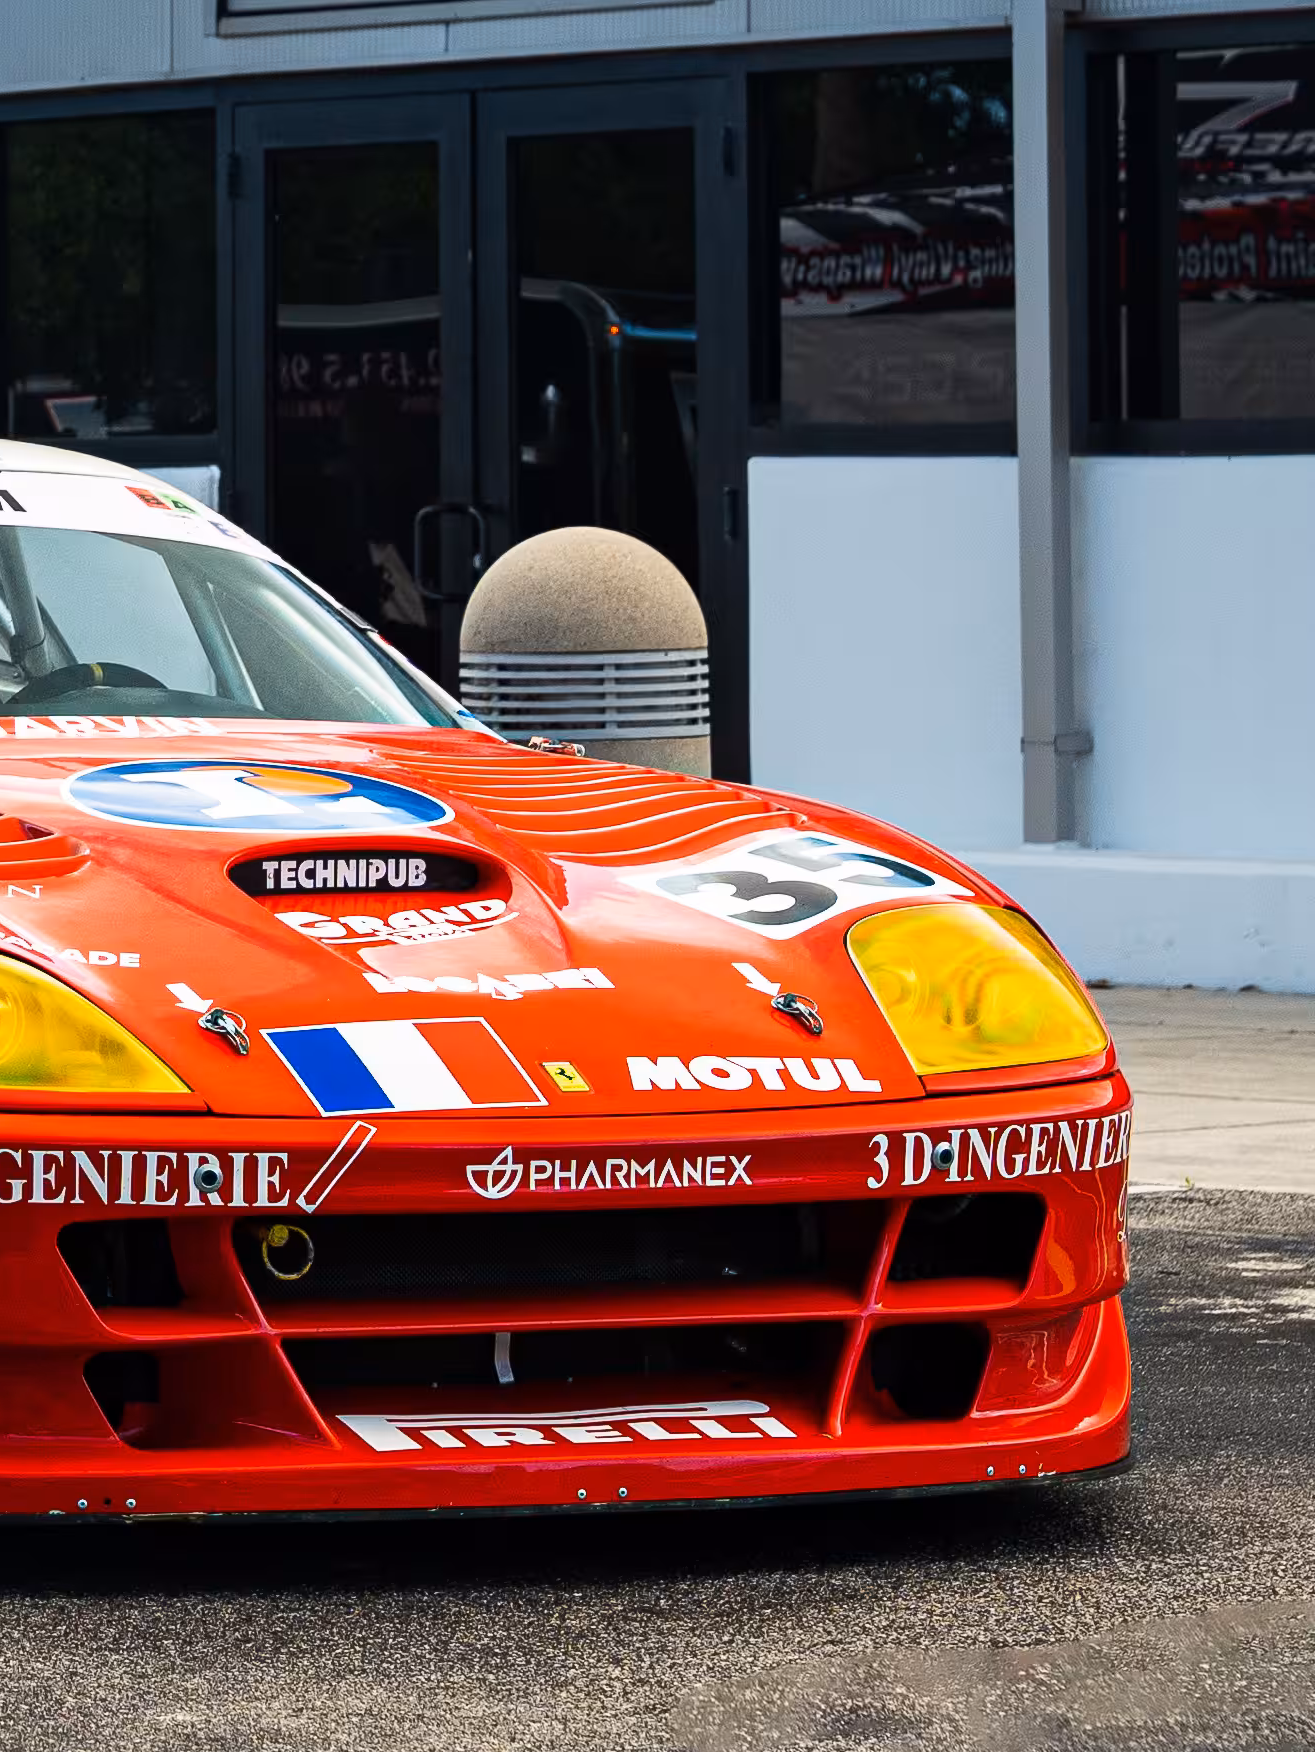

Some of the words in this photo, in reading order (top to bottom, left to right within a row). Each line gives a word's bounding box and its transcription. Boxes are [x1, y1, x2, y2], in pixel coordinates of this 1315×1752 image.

[262, 858, 428, 890] TECHNIPUB
[656, 836, 936, 926] 35
[273, 898, 509, 939] GRAND
[626, 1055, 883, 1093] MOTUL
[530, 1154, 753, 1191] PHARMANEX
[335, 1399, 799, 1453] PIRELLI
